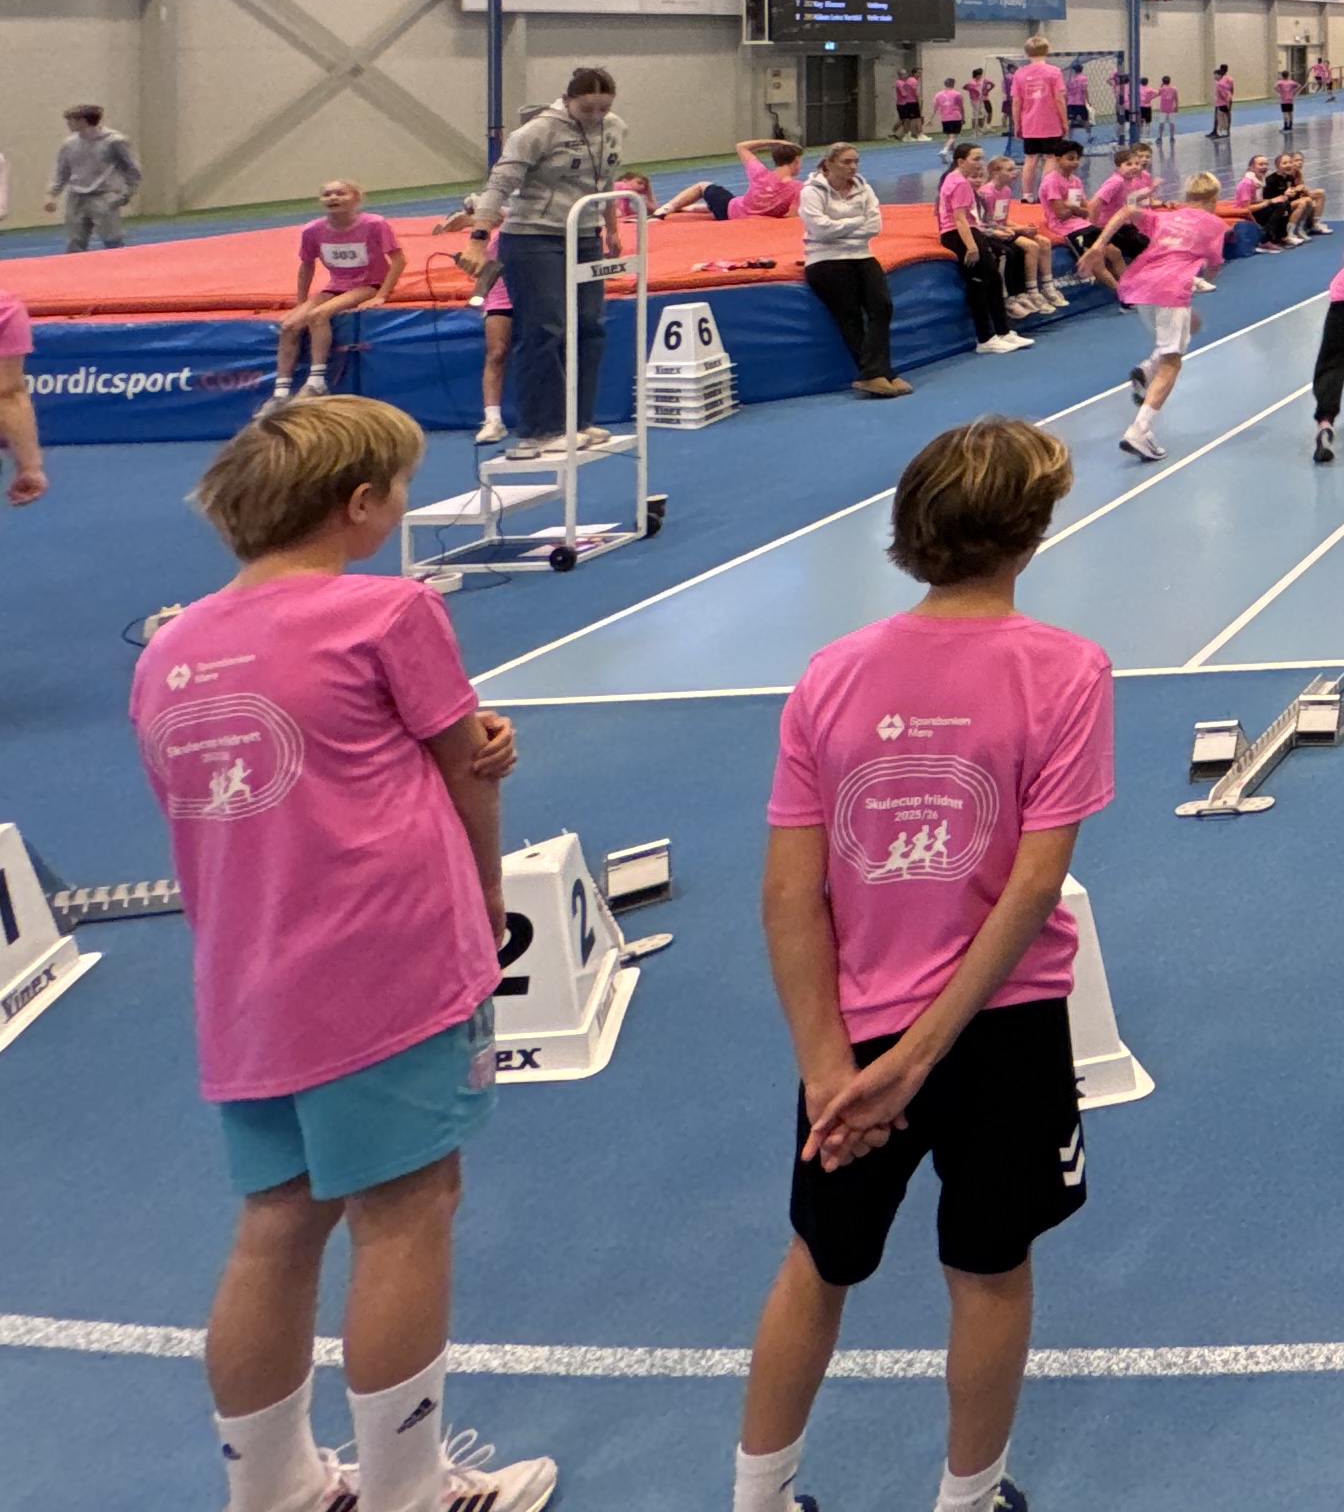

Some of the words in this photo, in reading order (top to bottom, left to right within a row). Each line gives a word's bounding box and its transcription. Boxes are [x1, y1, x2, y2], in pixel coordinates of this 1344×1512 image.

[590, 261, 627, 278] Vinex
[663, 320, 683, 350] 6
[698, 317, 713, 346] 6
[655, 365, 682, 375] Vinex
[908, 715, 971, 728] Sparebanken
[865, 794, 921, 810] Skulecup
[571, 879, 596, 968] 2
[0, 963, 57, 1025] Vinex
